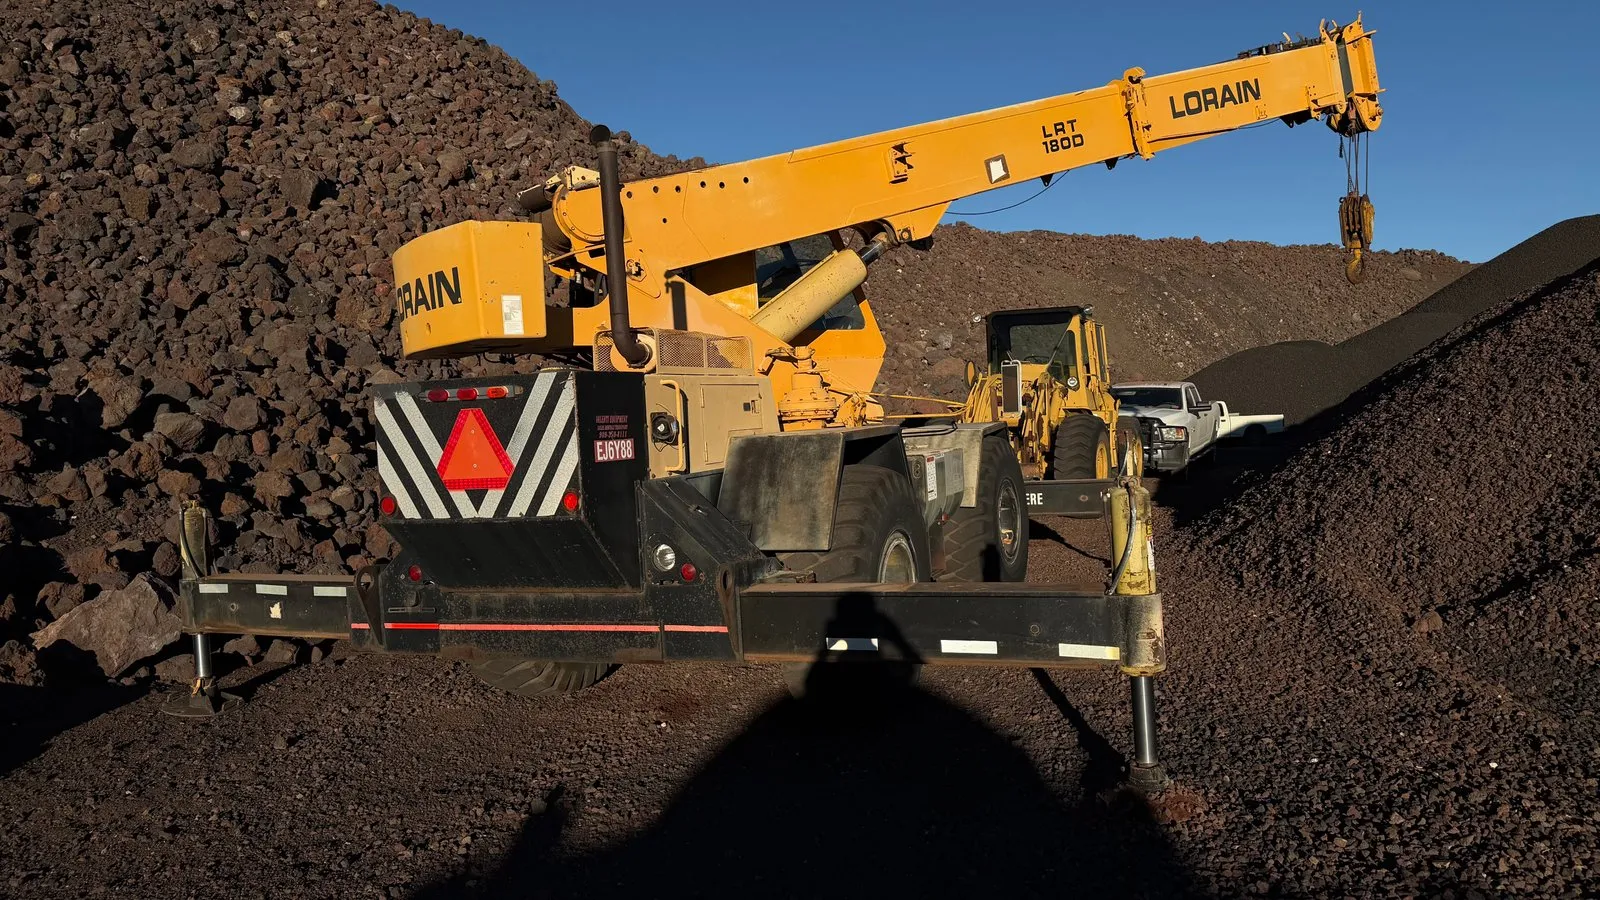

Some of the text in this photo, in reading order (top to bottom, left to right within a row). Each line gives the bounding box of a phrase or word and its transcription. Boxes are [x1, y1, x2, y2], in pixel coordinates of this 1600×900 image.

[1169, 78, 1261, 119] LORAIN
[1041, 118, 1077, 139] LRT
[1042, 133, 1084, 154] 180D
[596, 440, 633, 461] EJ6Y88
